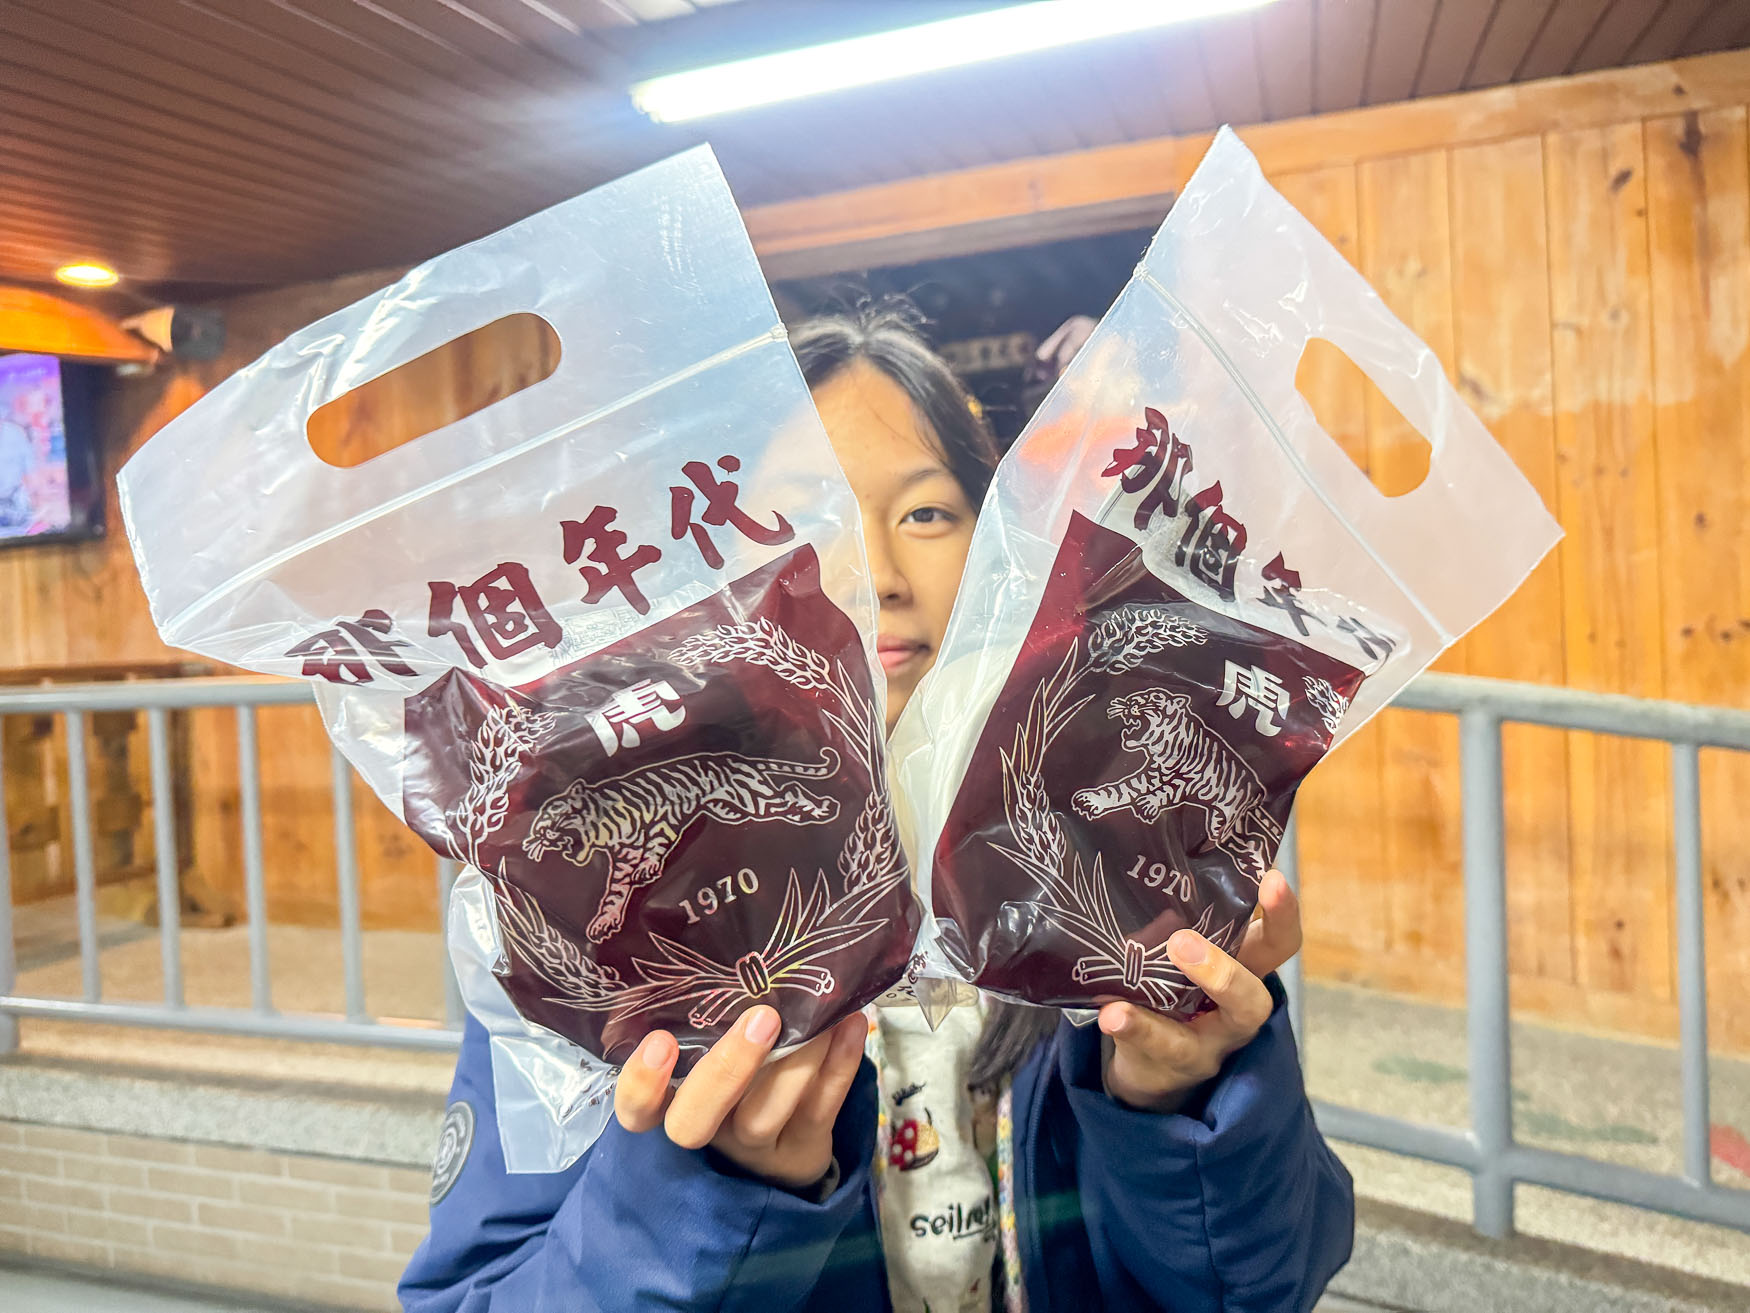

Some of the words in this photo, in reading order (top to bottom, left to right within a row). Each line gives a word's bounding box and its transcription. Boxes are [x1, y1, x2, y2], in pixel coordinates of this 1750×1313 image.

[584, 679, 687, 757] 虎
[1216, 659, 1290, 737] 虎
[678, 867, 759, 925] 1970
[1126, 854, 1192, 903] 1970
